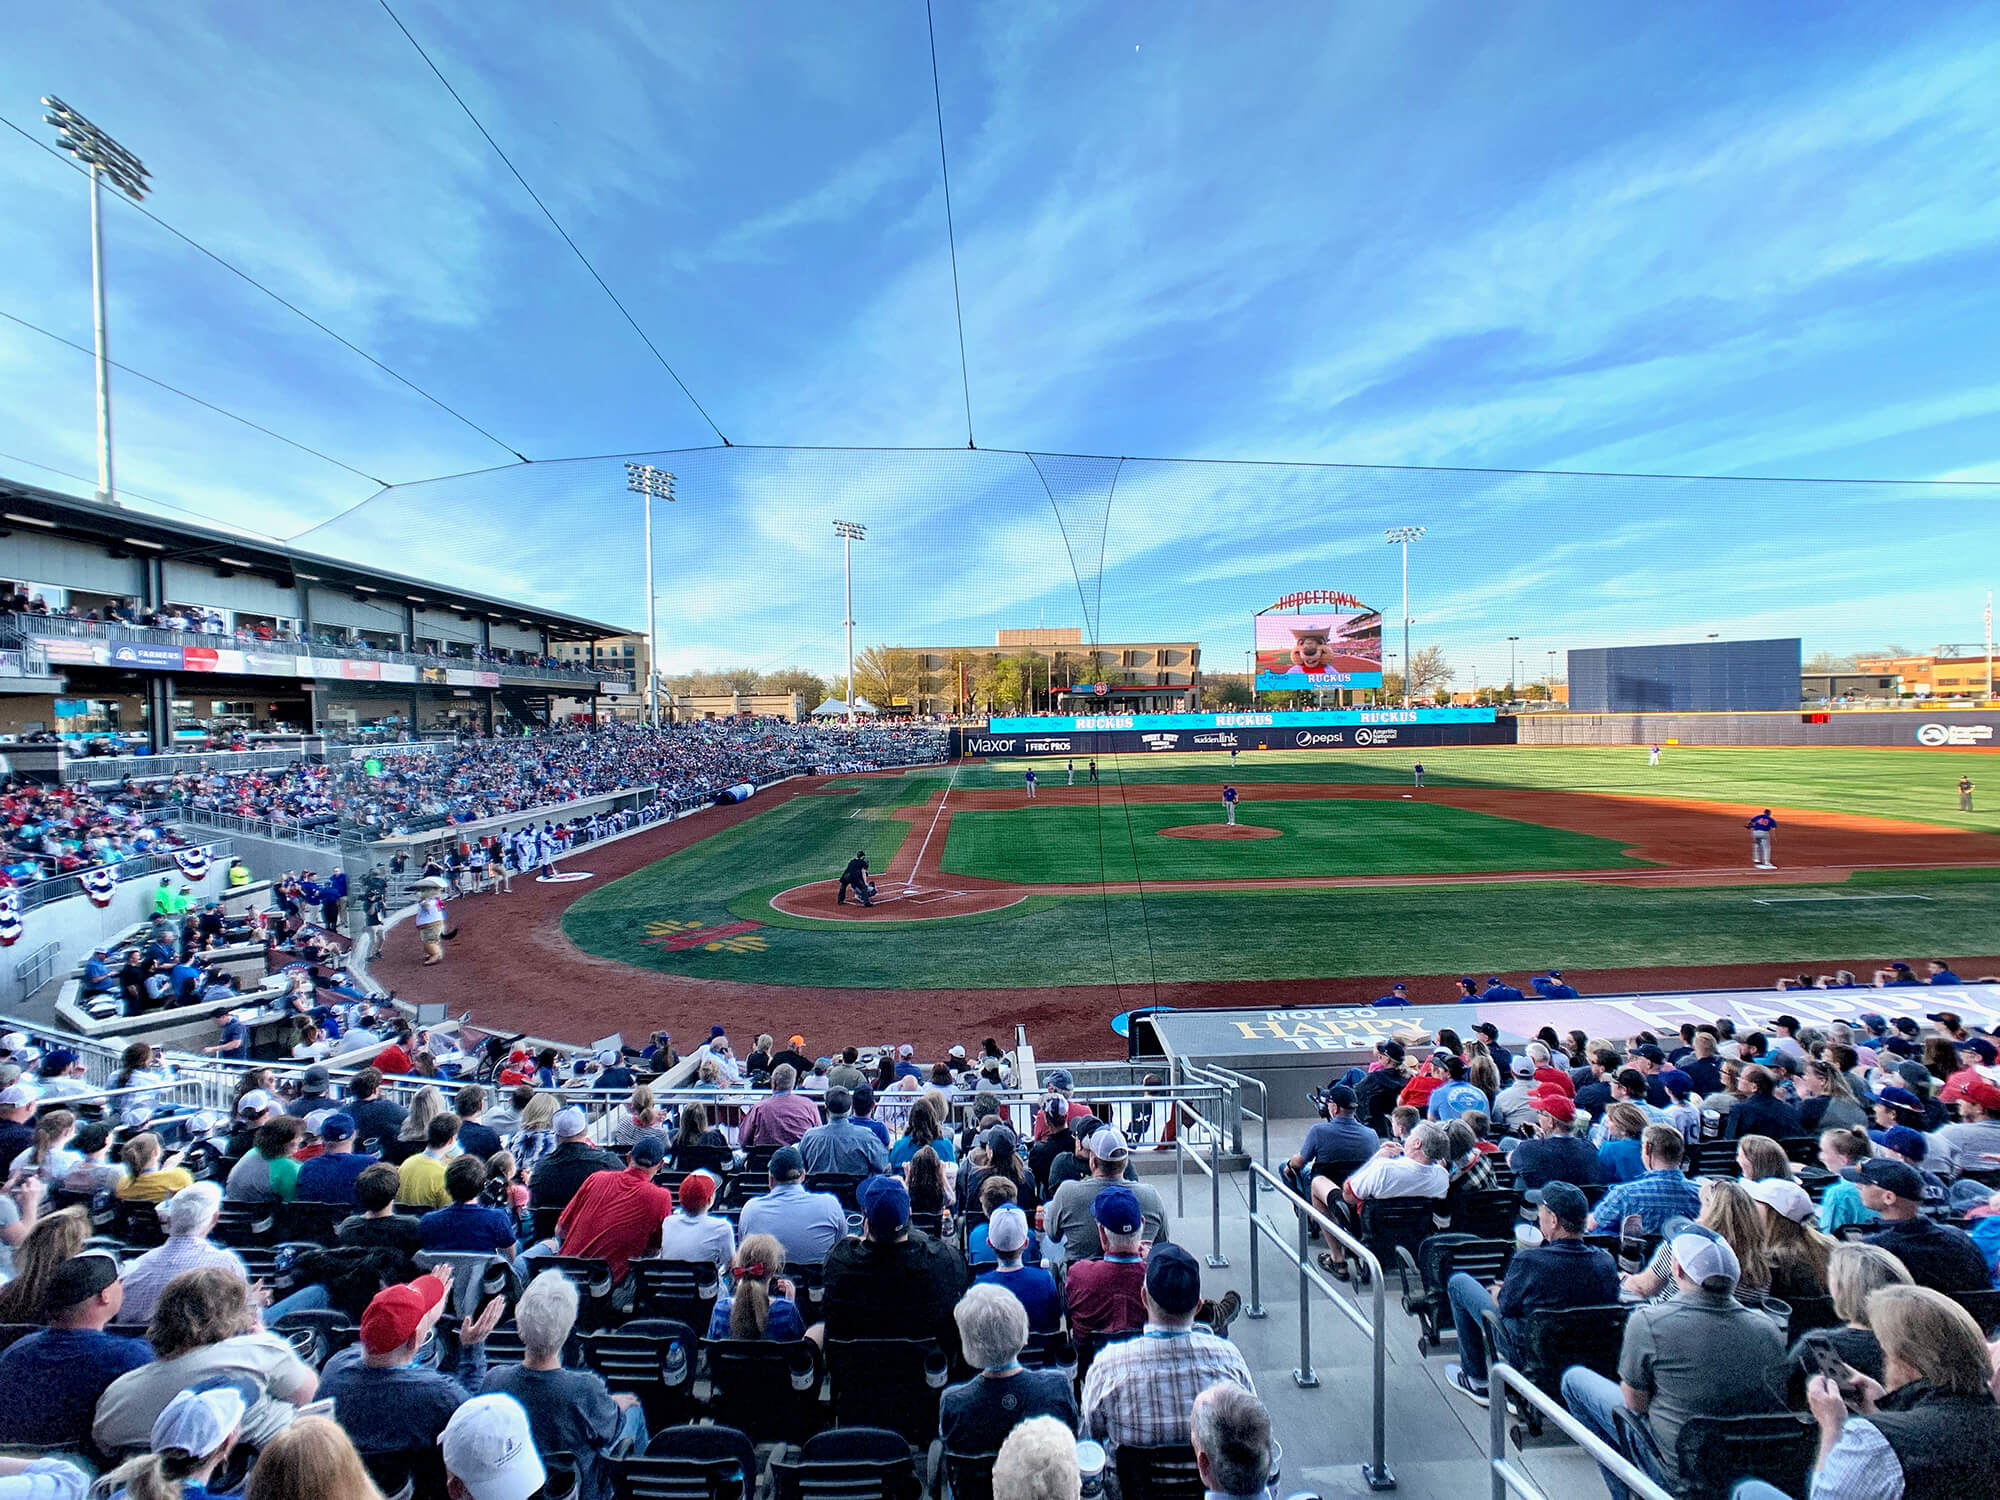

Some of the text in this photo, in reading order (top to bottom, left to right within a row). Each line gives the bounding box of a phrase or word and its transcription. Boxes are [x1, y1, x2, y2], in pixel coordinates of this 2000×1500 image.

[1279, 590, 1357, 610] HODGETOWN
[138, 650, 179, 660] FARMERS
[1307, 673, 1351, 683] RUCKUS
[1075, 717, 1133, 730] RUCKUS
[1215, 714, 1273, 727] RUCKUS
[1360, 711, 1417, 723] RUCKUS
[968, 738, 1016, 752] Maxor
[1312, 732, 1344, 745] pepsi
[1030, 743, 1050, 751] FERG
[1050, 742, 1071, 751] PROS
[1266, 1008, 1378, 1021] NOT SO
[1229, 1017, 1433, 1039] HAPPY
